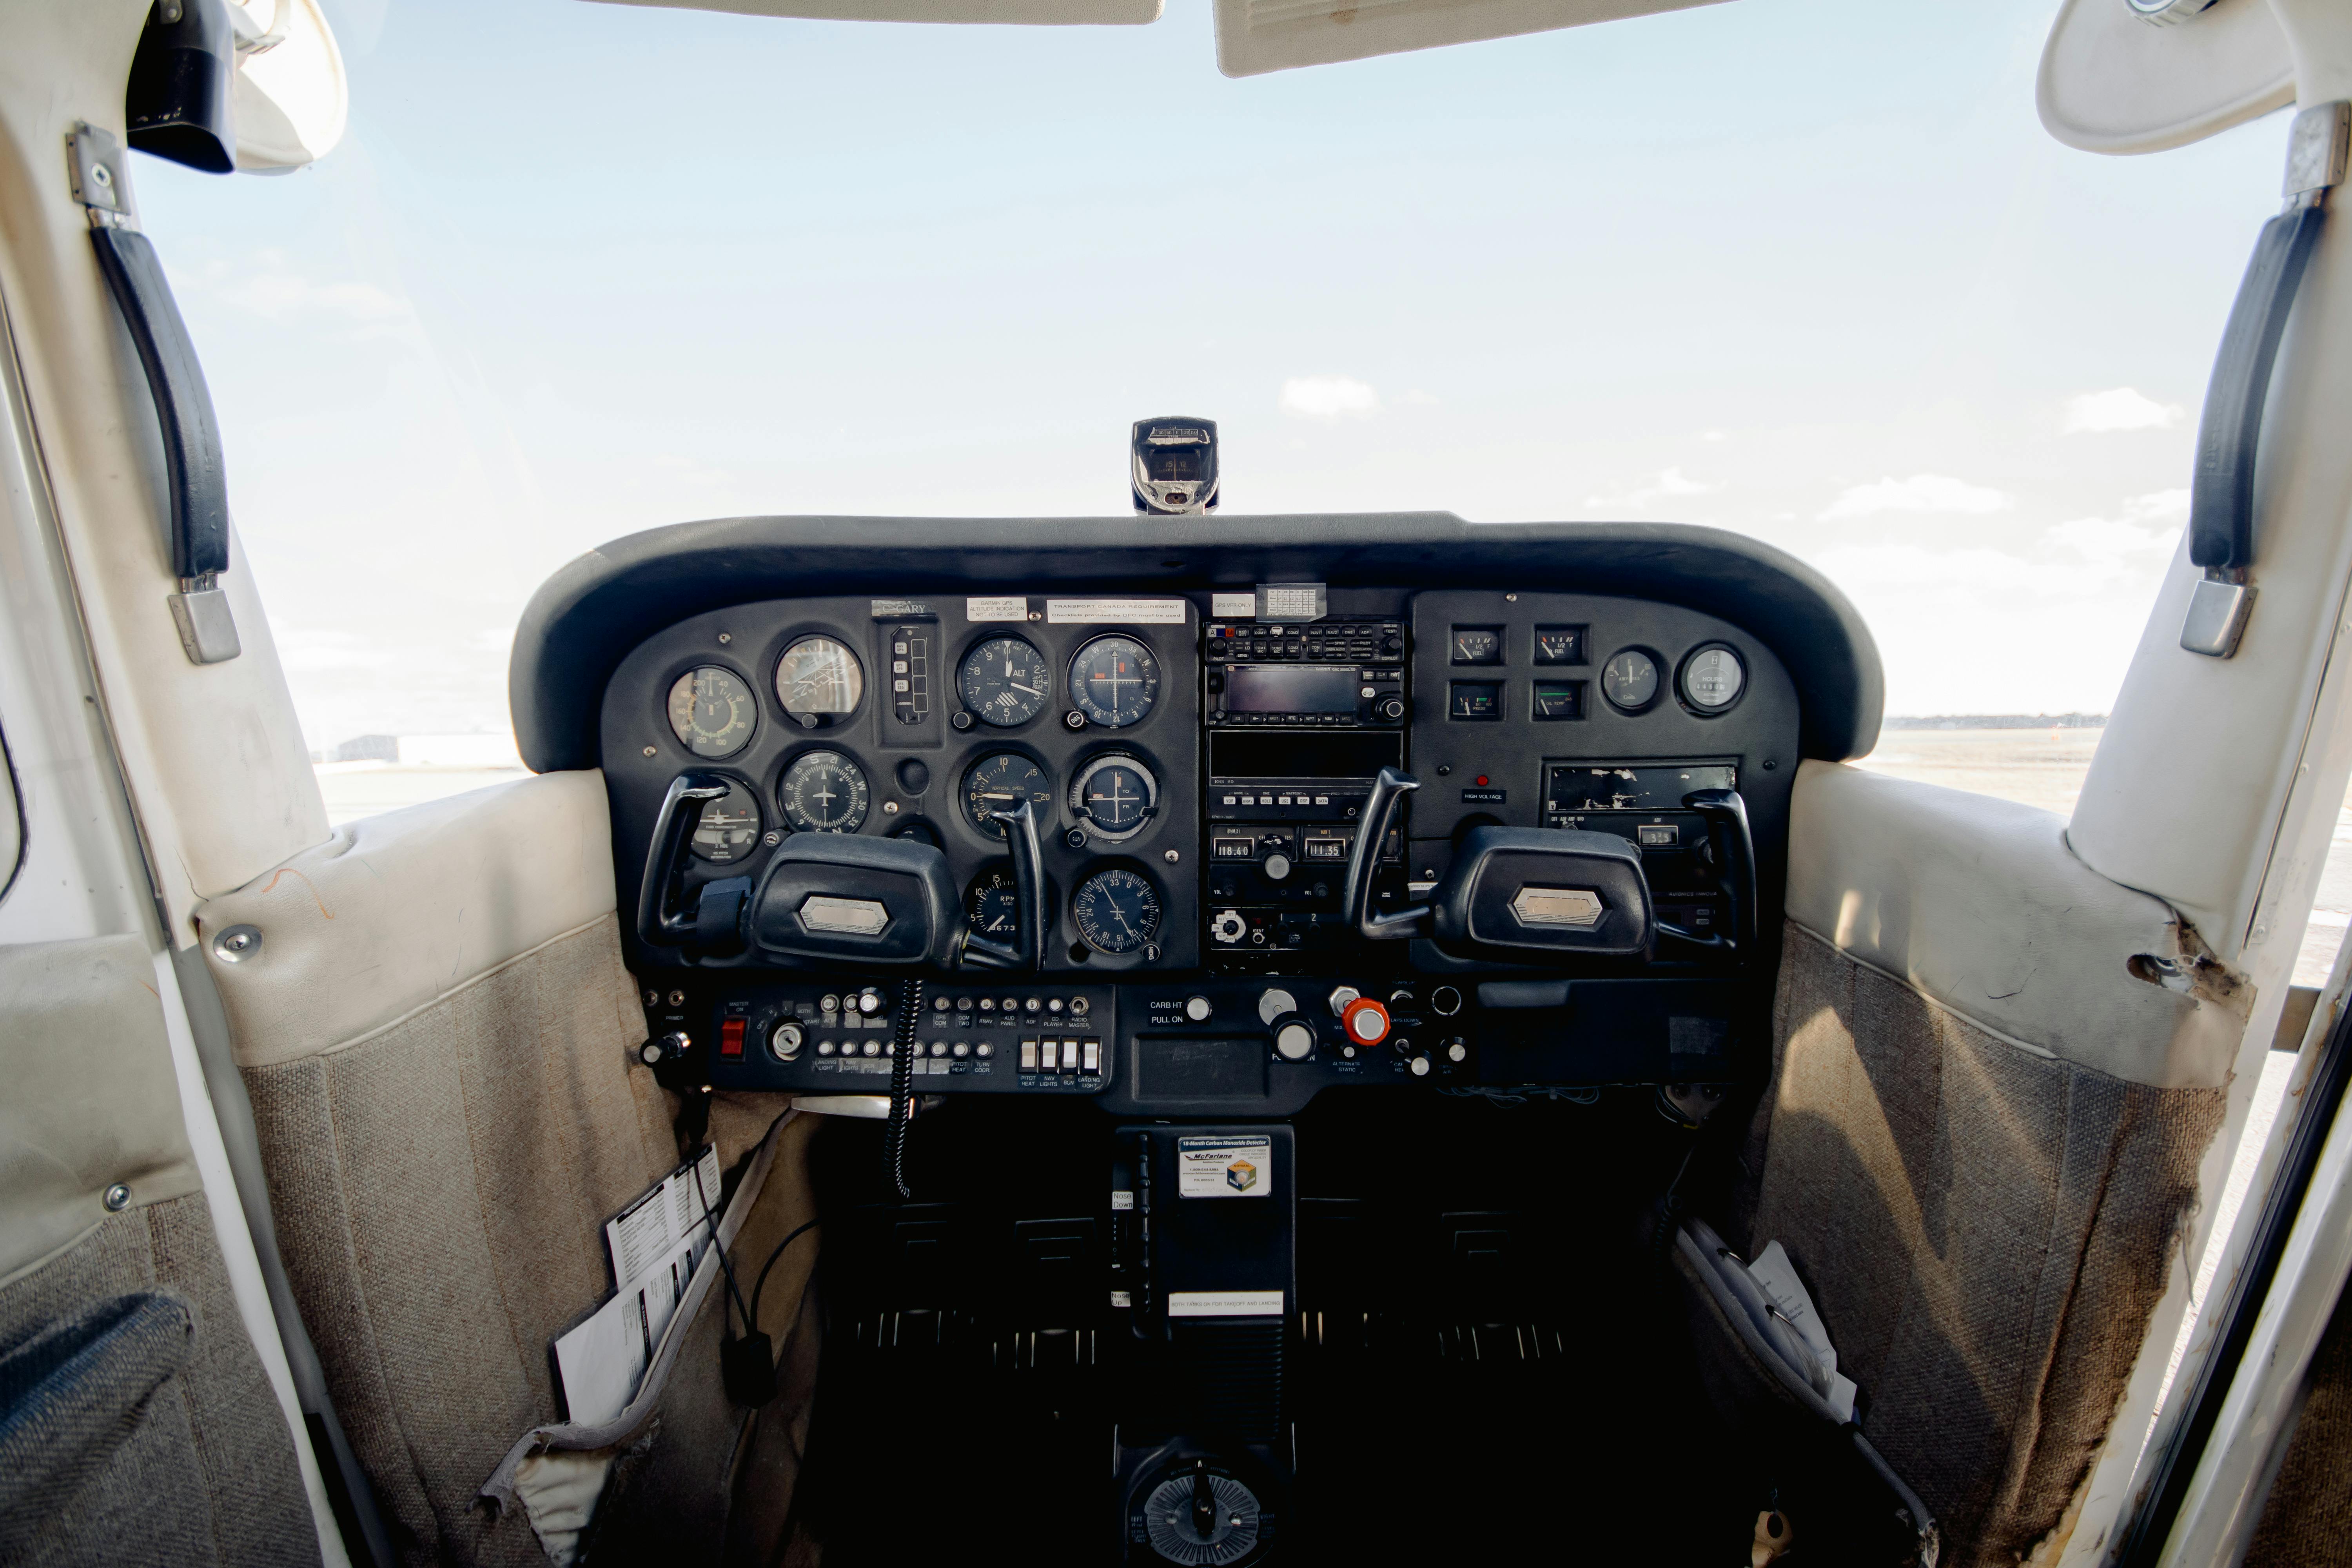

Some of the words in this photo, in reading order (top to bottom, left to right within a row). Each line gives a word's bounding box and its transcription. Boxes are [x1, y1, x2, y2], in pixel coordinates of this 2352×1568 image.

[882, 605, 926, 613] C-GARY
[986, 652, 993, 661] 9
[974, 667, 980, 675] 8
[1034, 665, 1040, 674] 2
[974, 687, 980, 695] 7
[986, 702, 992, 710] 6
[1022, 703, 1028, 711] 4
[1004, 708, 1010, 717] 5
[1071, 715, 1080, 724] OBS
[810, 755, 819, 764] S
[845, 764, 857, 775] 24
